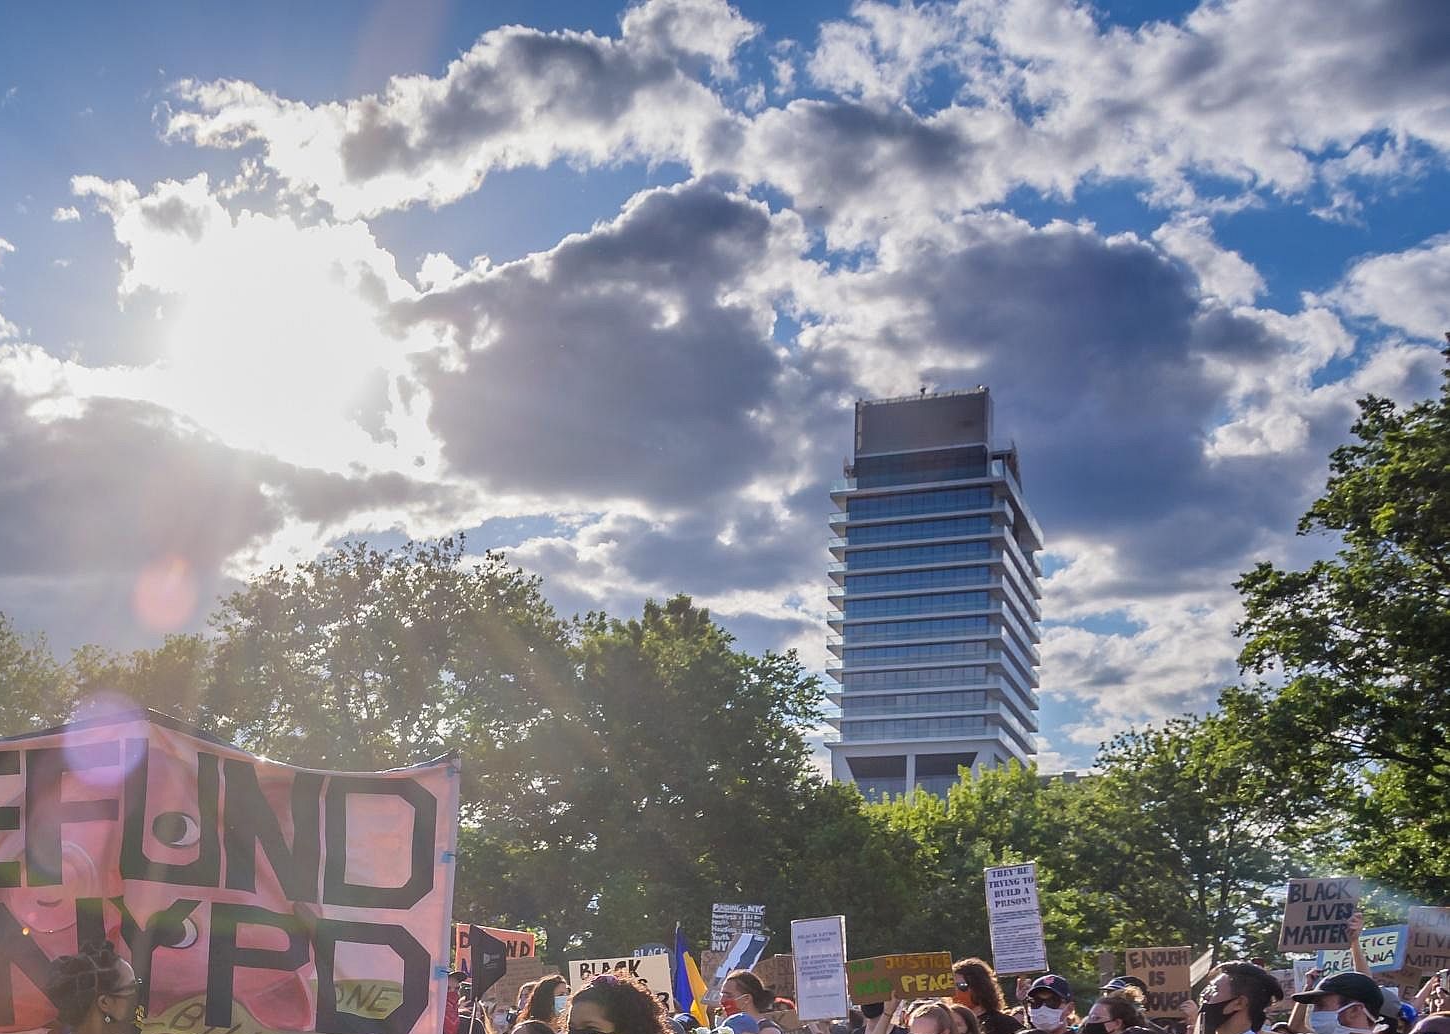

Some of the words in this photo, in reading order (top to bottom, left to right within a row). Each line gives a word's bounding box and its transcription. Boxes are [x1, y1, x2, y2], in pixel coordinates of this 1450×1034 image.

[994, 888, 1021, 898] BUILD
[1288, 880, 1352, 904] BLACK
[1307, 903, 1354, 921] LIVES
[1283, 923, 1348, 946] MATTER
[1360, 936, 1398, 948] TICE
[886, 953, 950, 969] JUSTICE
[1129, 950, 1188, 969] ENOUGH
[1405, 954, 1450, 969] MATT
[901, 973, 955, 993] PEACE
[1149, 971, 1165, 986] IS
